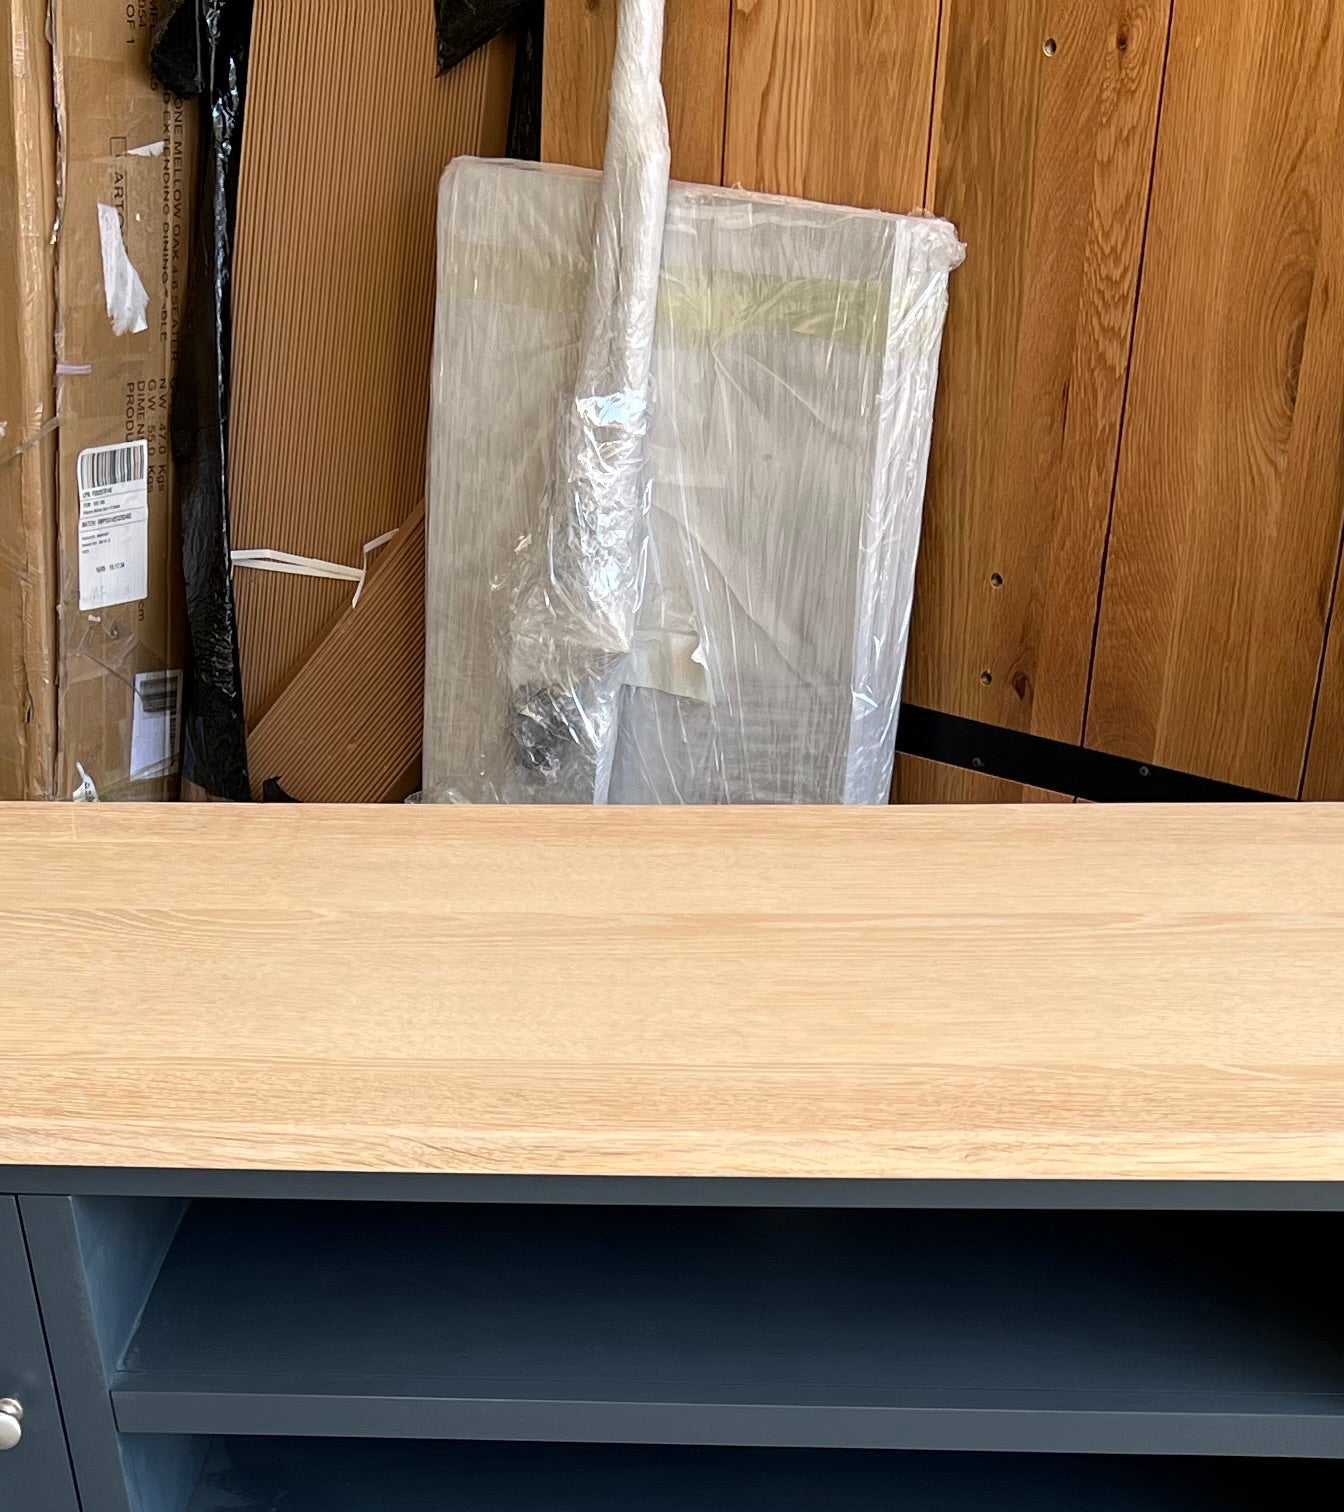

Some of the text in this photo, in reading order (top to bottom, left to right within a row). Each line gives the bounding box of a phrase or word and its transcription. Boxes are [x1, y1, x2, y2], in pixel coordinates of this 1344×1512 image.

[126, 4, 135, 29] OF
[174, 141, 182, 218] MELLOW
[172, 224, 181, 260] OAK
[171, 295, 179, 362] SEATER
[159, 422, 167, 455] 47.0
[157, 465, 167, 492] Kgs
[138, 602, 145, 621] cm
